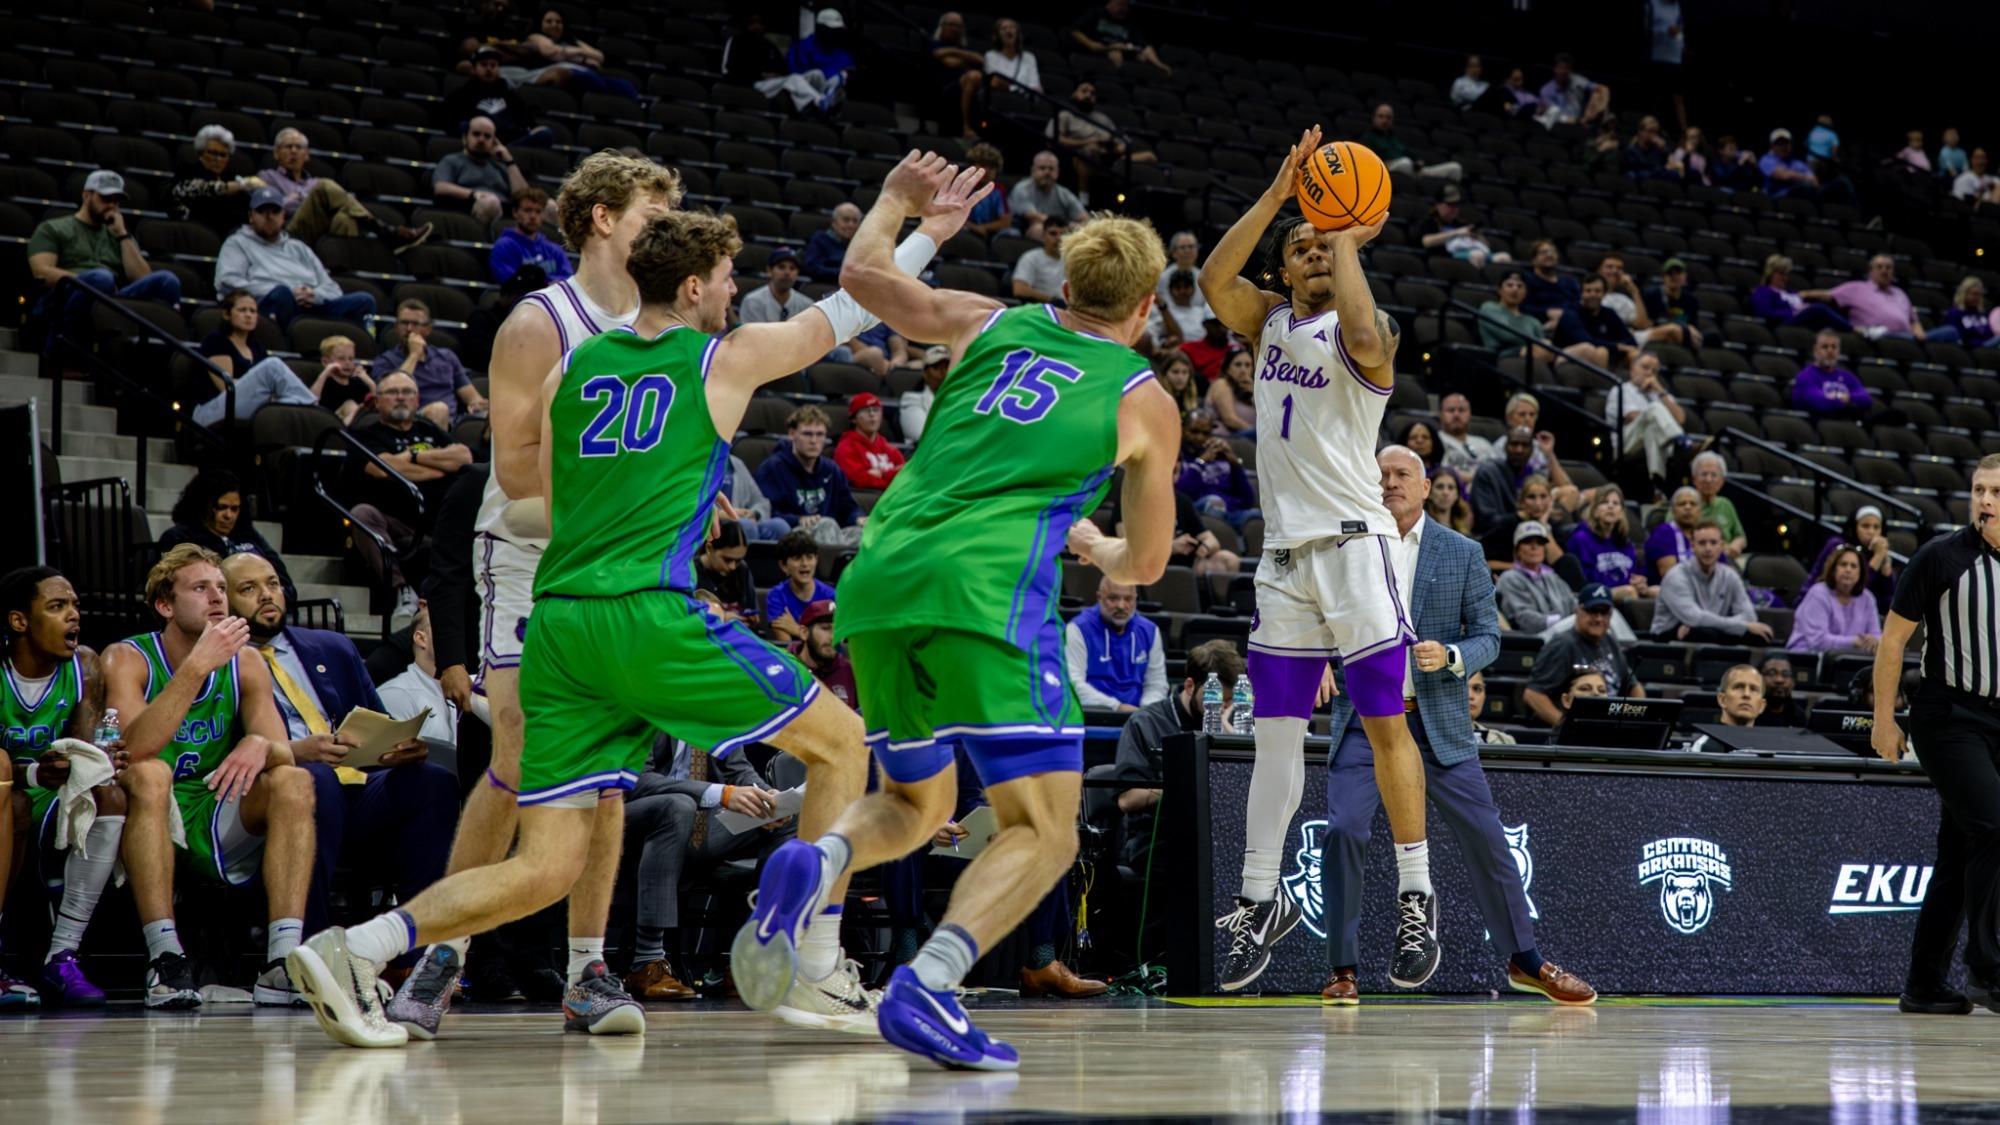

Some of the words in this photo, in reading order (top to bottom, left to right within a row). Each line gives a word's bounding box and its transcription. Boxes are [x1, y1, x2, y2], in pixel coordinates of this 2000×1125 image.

[972, 346, 1086, 425] 15
[1260, 344, 1330, 389] Bears
[579, 374, 677, 458] 20
[1281, 392, 1294, 441] 1
[174, 712, 225, 745] GCU
[1638, 853, 1732, 881] ARKANSAS
[1642, 837, 1727, 862] CENTRAL
[1832, 864, 1935, 904] EKU
